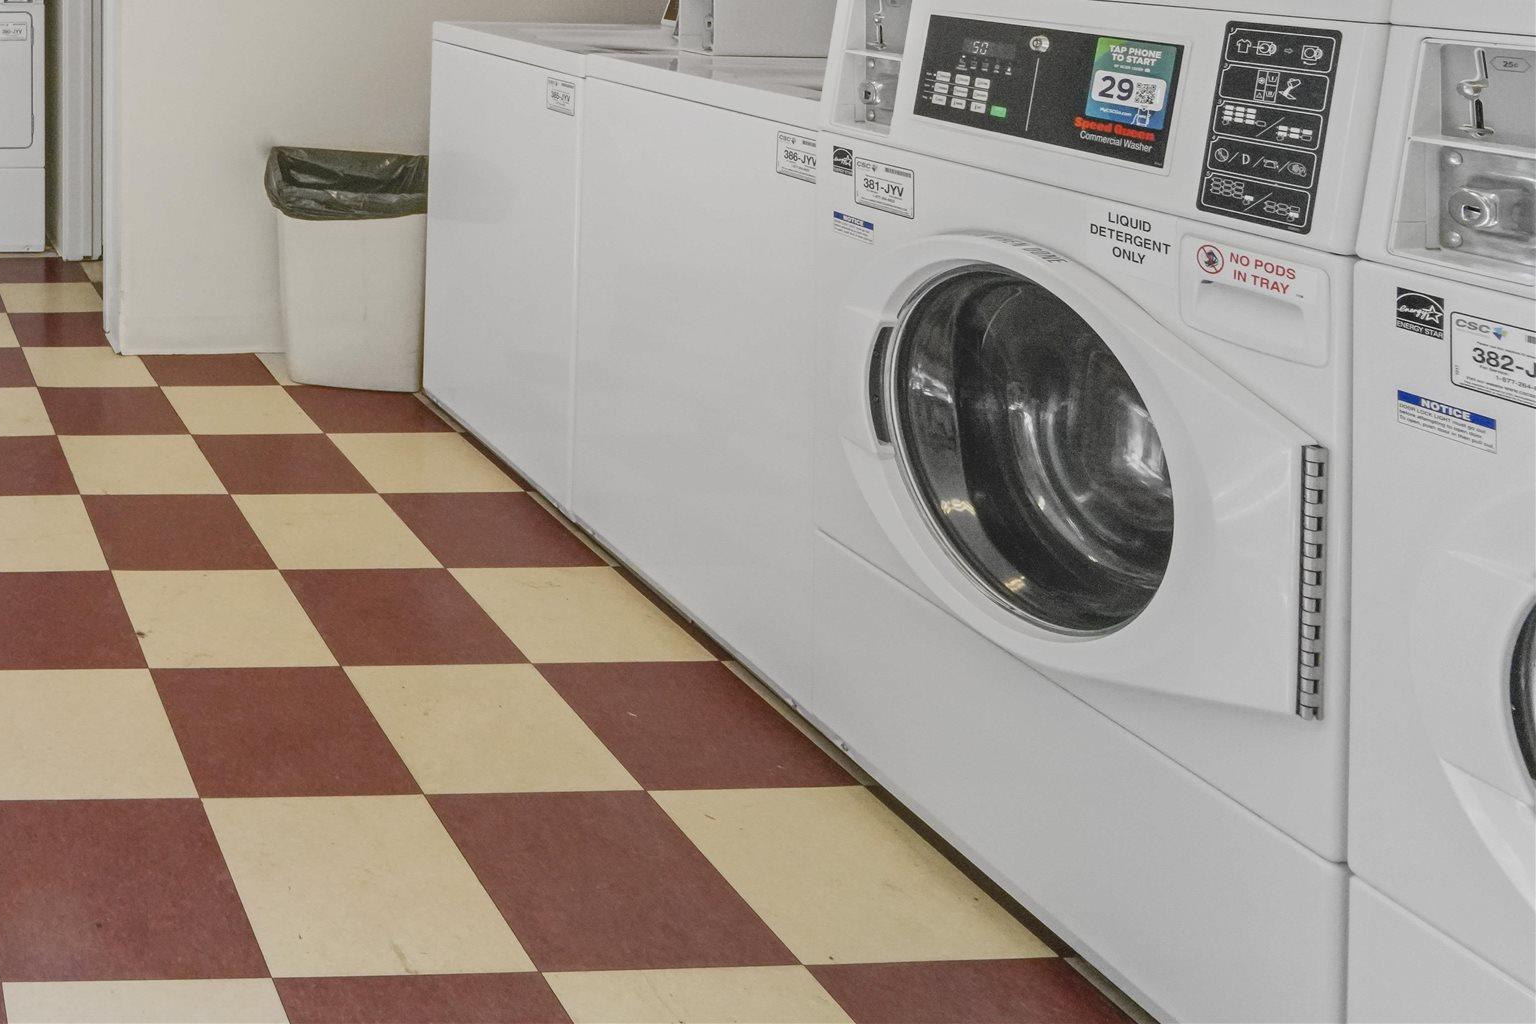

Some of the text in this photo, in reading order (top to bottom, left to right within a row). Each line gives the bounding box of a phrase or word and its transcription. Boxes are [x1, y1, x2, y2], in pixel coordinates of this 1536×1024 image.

[972, 41, 989, 55] 50
[1109, 44, 1162, 59] TAP PHONE
[1112, 53, 1157, 66] TO START
[1098, 75, 1134, 101] 29
[1074, 116, 1156, 142] Speed Queen
[1080, 130, 1152, 153] Commercial Washer
[856, 161, 871, 169] CSC
[863, 178, 904, 197] 381-JYV
[1108, 212, 1151, 232] LIQUID
[1090, 223, 1171, 254] DETERGENT
[1112, 246, 1146, 264] ONLY
[1229, 252, 1296, 280] NO PODS
[1233, 269, 1290, 294] IN TRAY
[1396, 319, 1444, 340] ENERGY STAR
[1455, 318, 1491, 334] CSC
[1420, 398, 1471, 421] NOTICE
